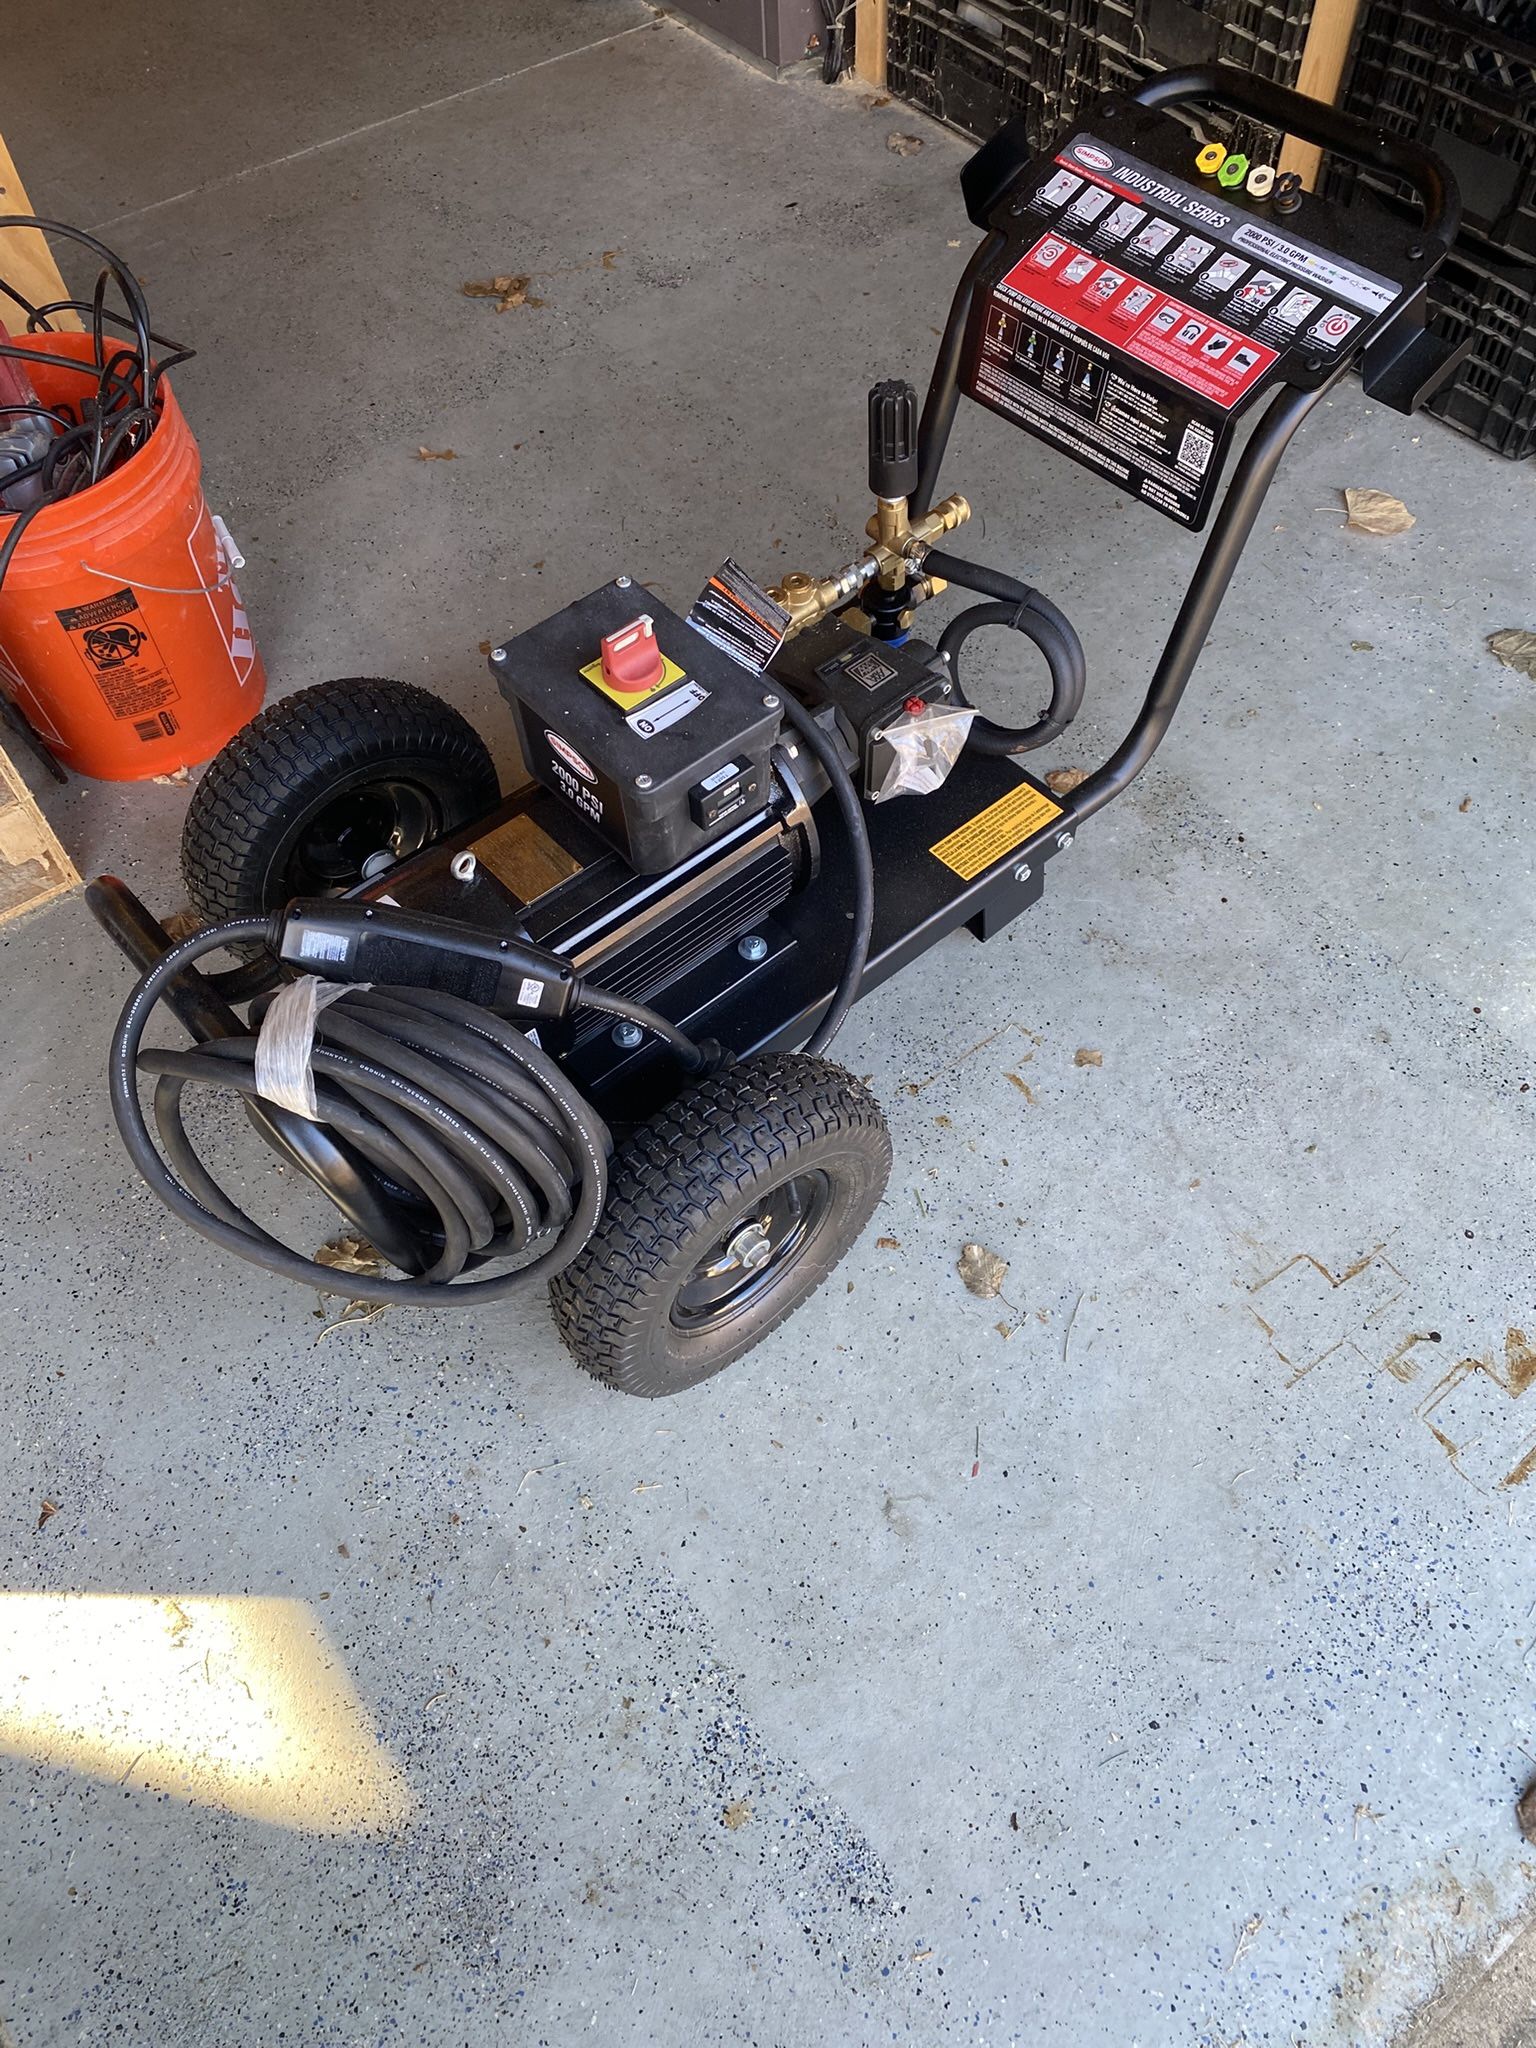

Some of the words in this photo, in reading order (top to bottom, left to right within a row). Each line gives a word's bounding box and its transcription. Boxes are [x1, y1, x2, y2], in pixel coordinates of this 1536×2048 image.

[1076, 148, 1110, 168] SIMPSON
[1112, 166, 1187, 208] INDUSTRIAL
[1183, 198, 1231, 229] SERIES
[1244, 228, 1262, 241] 2000
[1261, 236, 1274, 248] PSI
[1277, 244, 1290, 254] 3.0
[1288, 249, 1308, 263] GPM
[77, 605, 135, 628] AVERTISSEMENT
[690, 688, 705, 701] OFF
[638, 720, 653, 733] ON
[551, 737, 592, 776] SIMPSON
[551, 760, 579, 792] 2000
[583, 785, 603, 814] PSI
[560, 781, 574, 799] 3.0
[576, 795, 600, 823] GPM
[358, 1063, 386, 1079] NINGBO
